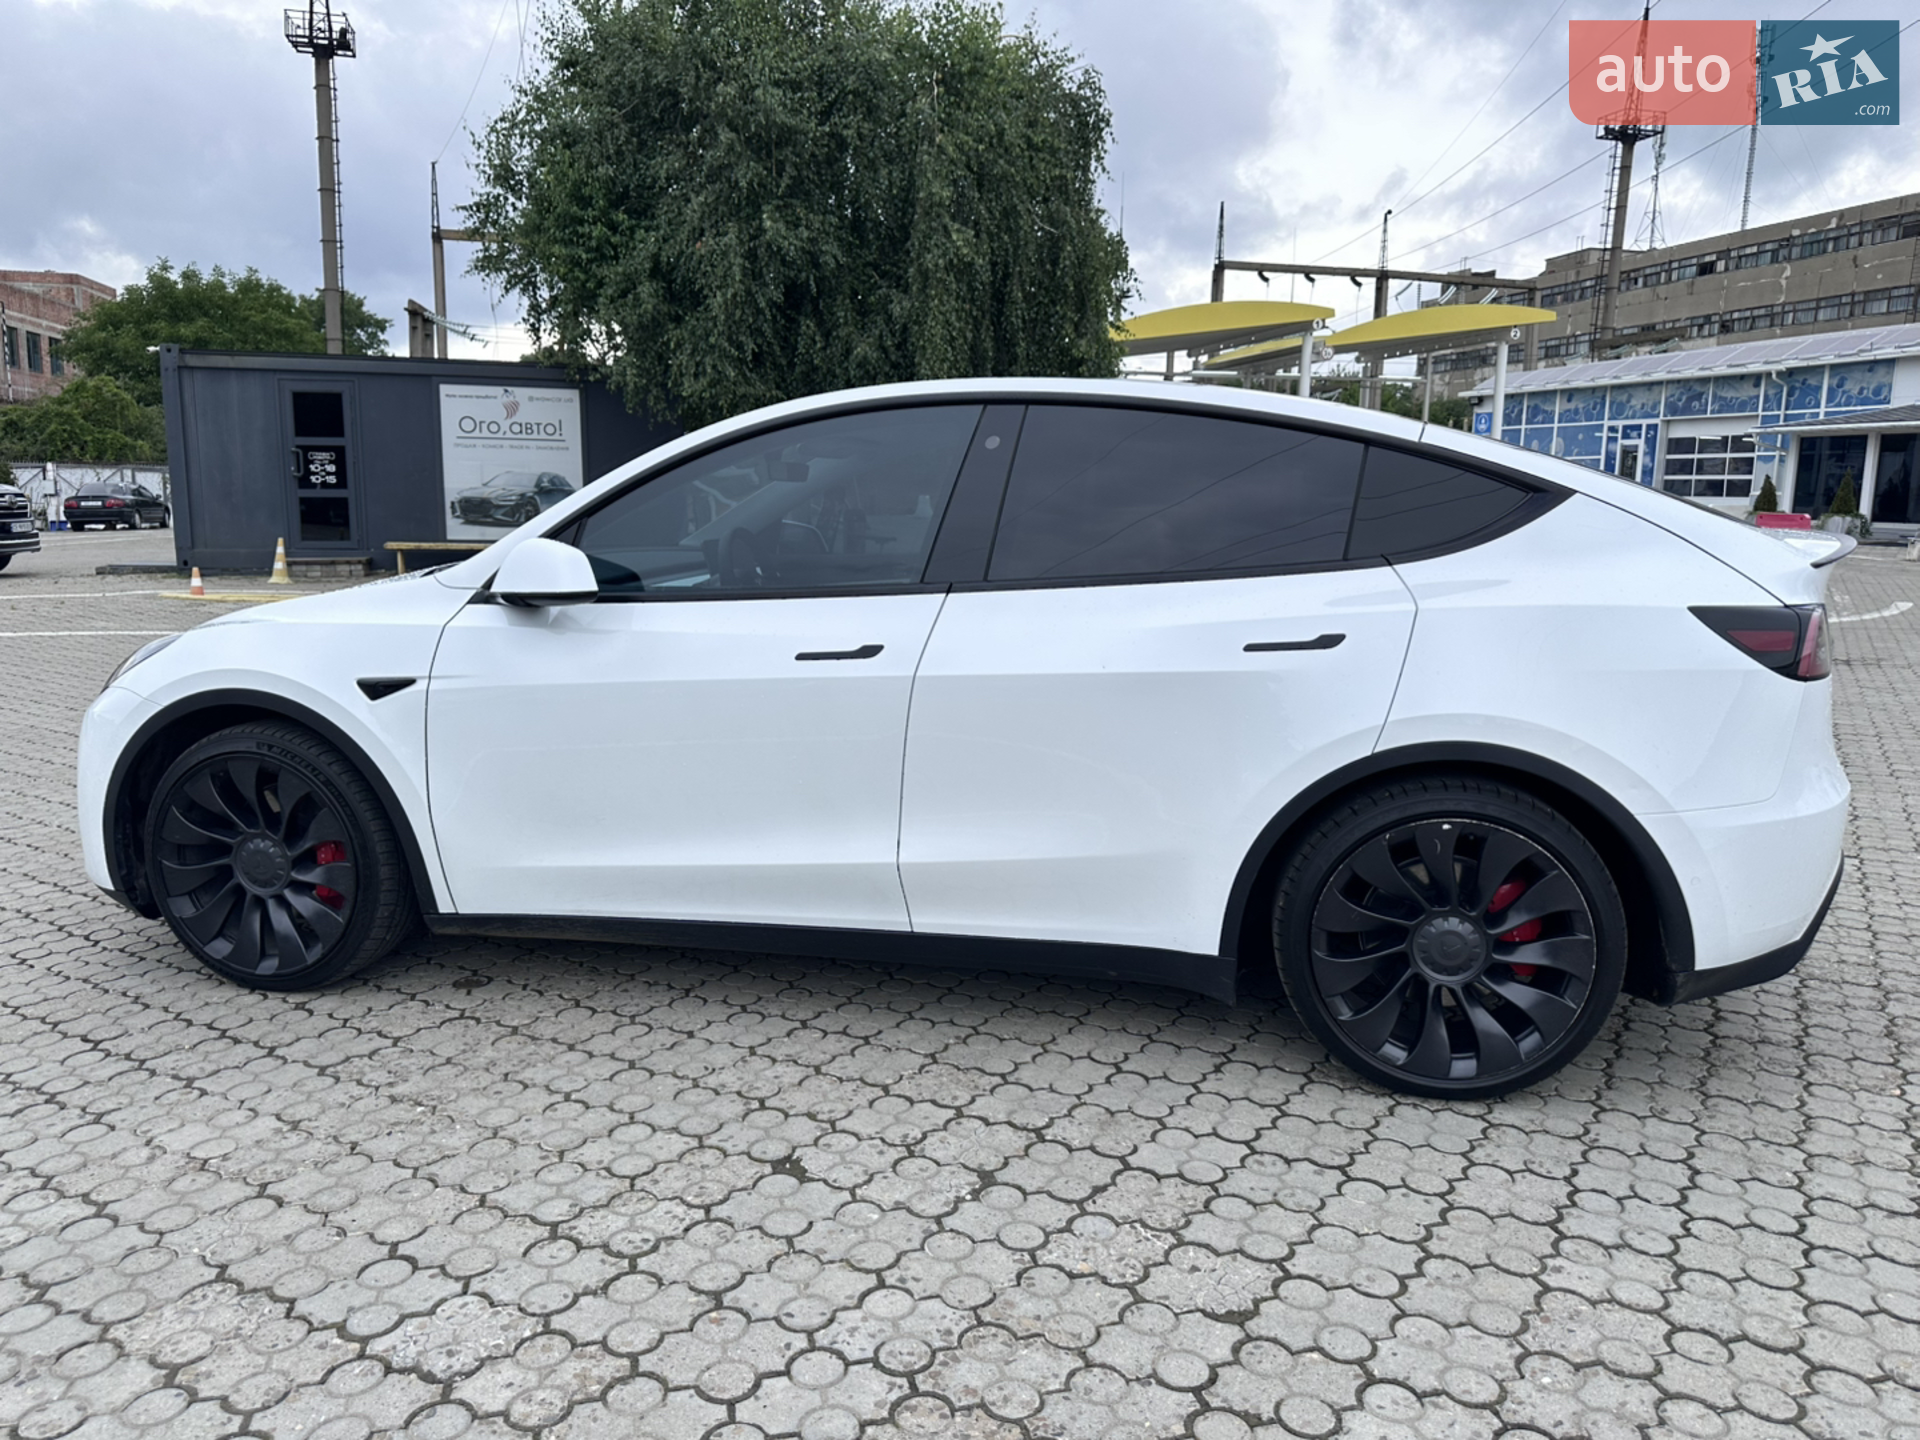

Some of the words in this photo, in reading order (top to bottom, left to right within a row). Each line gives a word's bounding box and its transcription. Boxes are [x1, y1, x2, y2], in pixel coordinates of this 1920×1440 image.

[309, 463, 336, 473] 10-18
[309, 475, 337, 484] 10-15
[271, 746, 326, 782] MICHELIN
